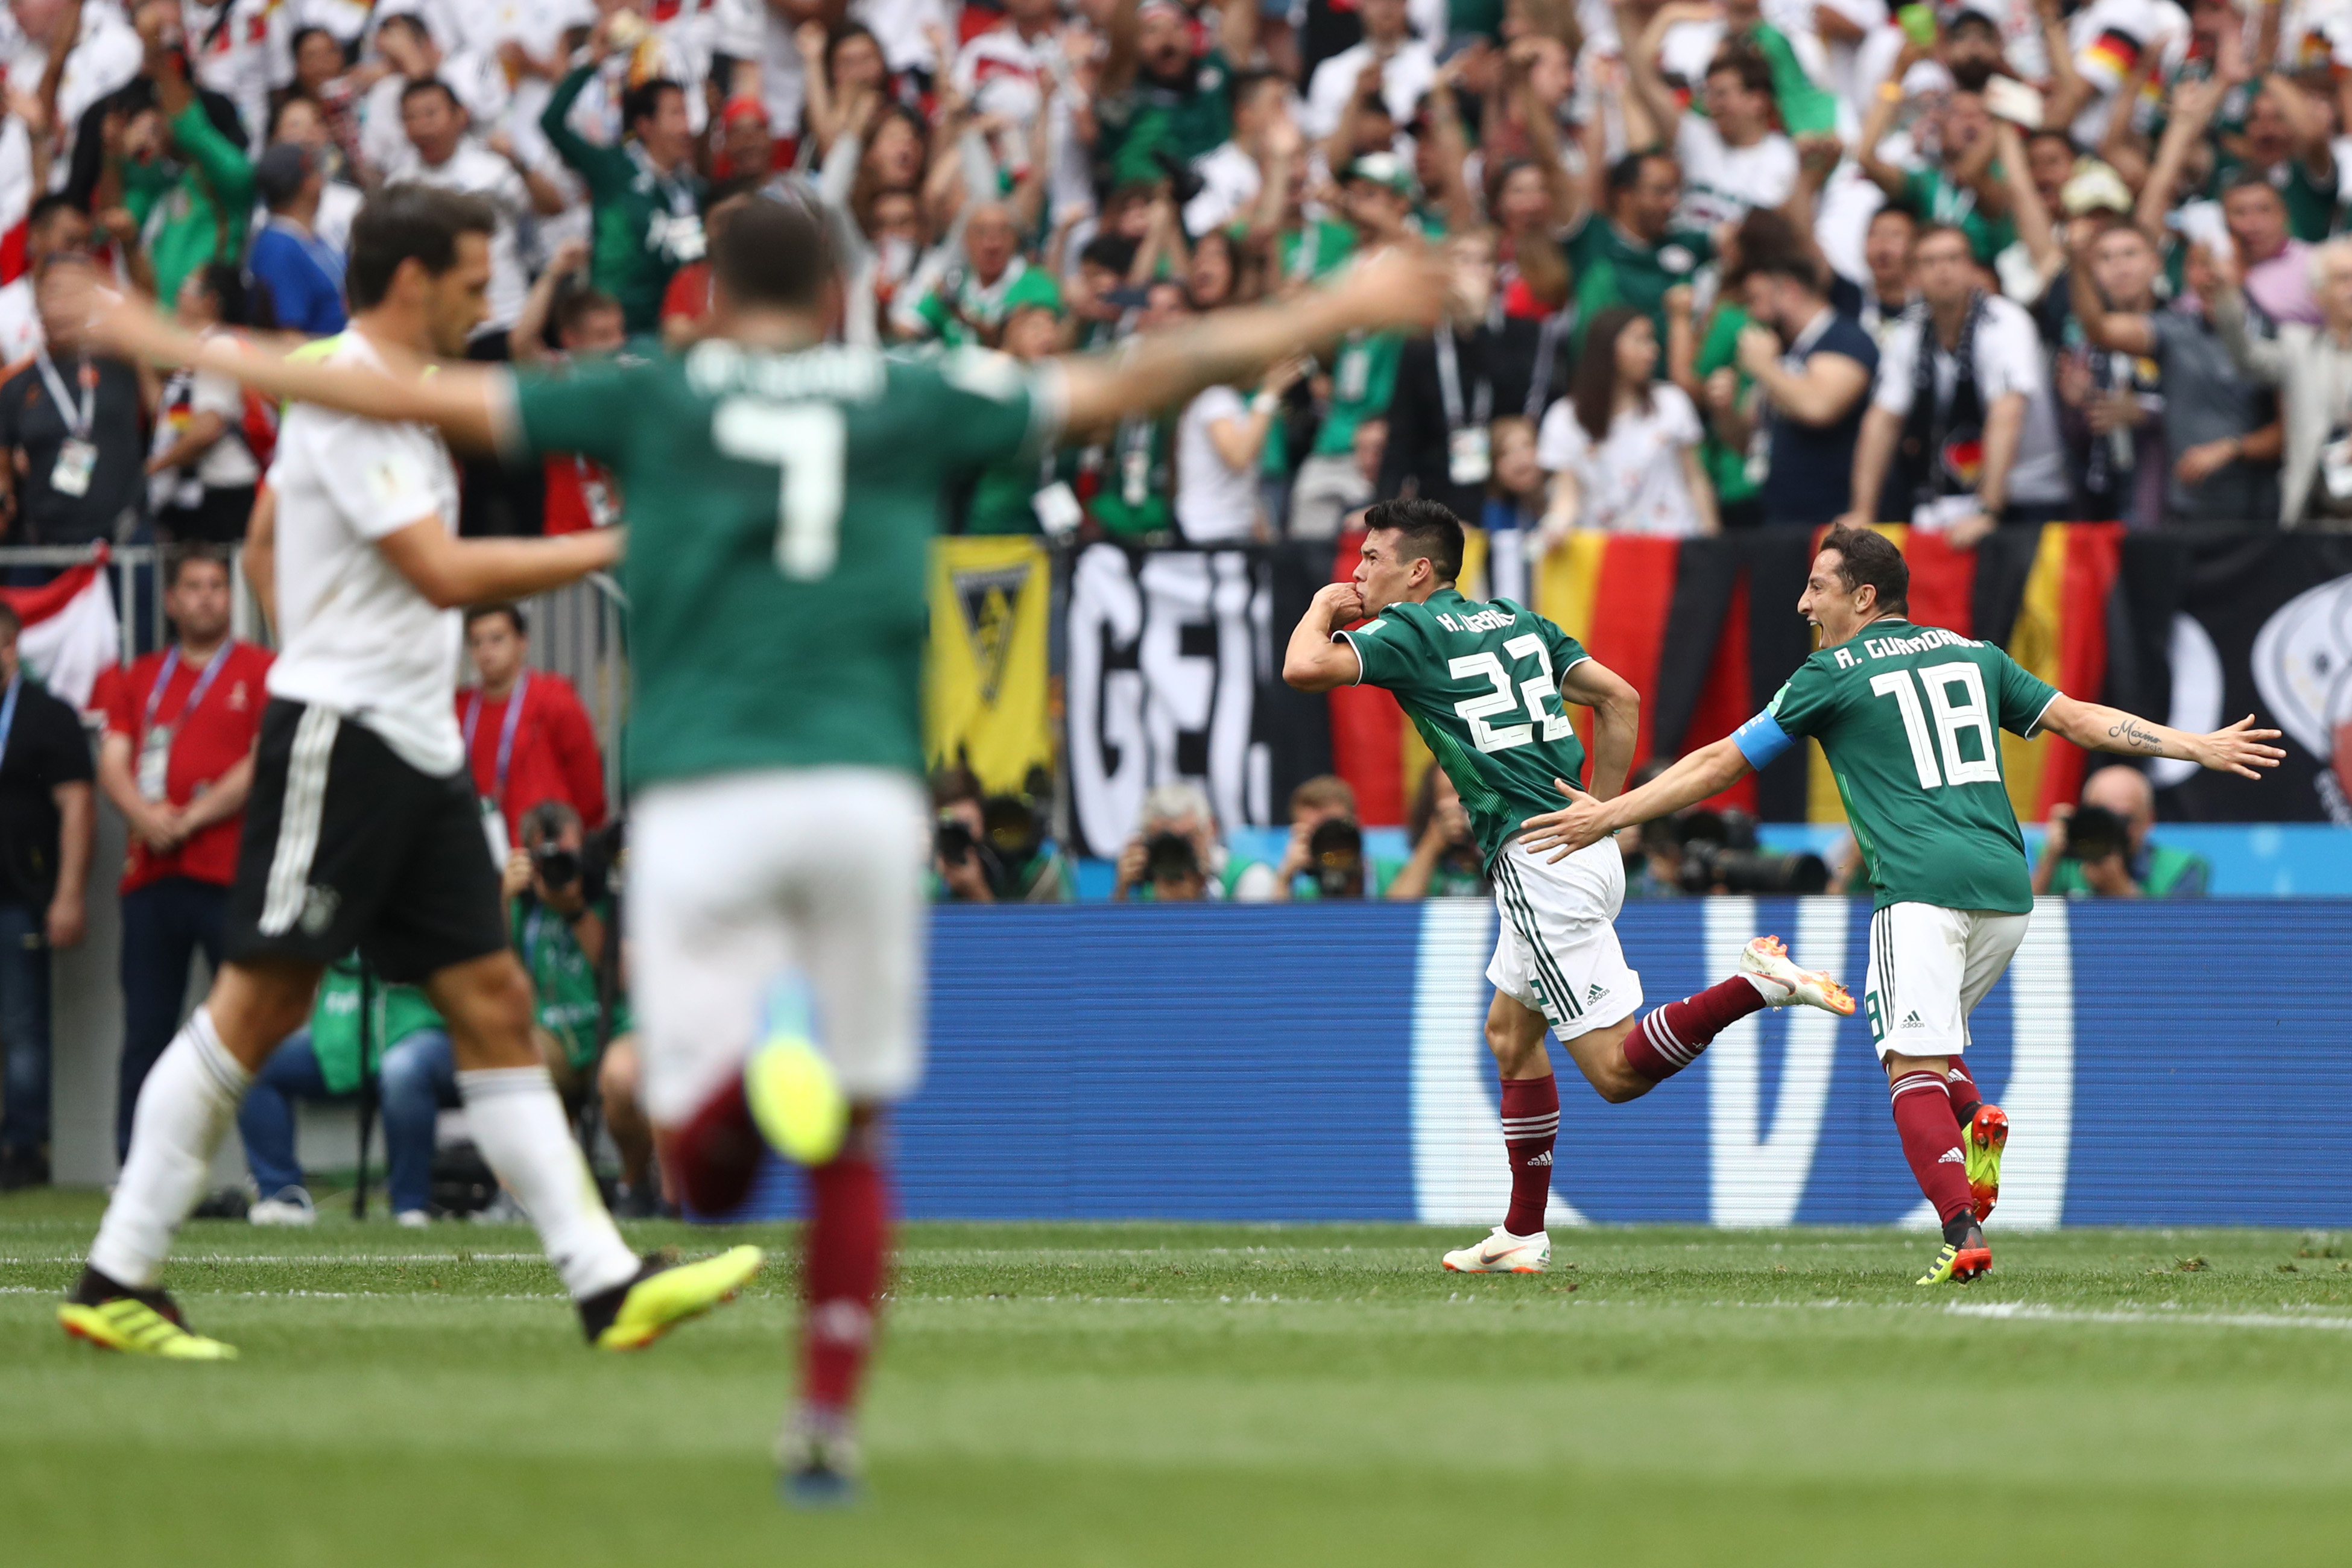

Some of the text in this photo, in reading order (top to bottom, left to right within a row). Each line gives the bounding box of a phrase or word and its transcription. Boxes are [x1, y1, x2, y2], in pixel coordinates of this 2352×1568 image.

[712, 397, 847, 583] 7
[1448, 633, 1573, 754] 22
[1834, 647, 1863, 669] A.
[1869, 662, 2001, 789] 18
[1587, 988, 1610, 1006] adidas
[1900, 1020, 1925, 1029] adidas
